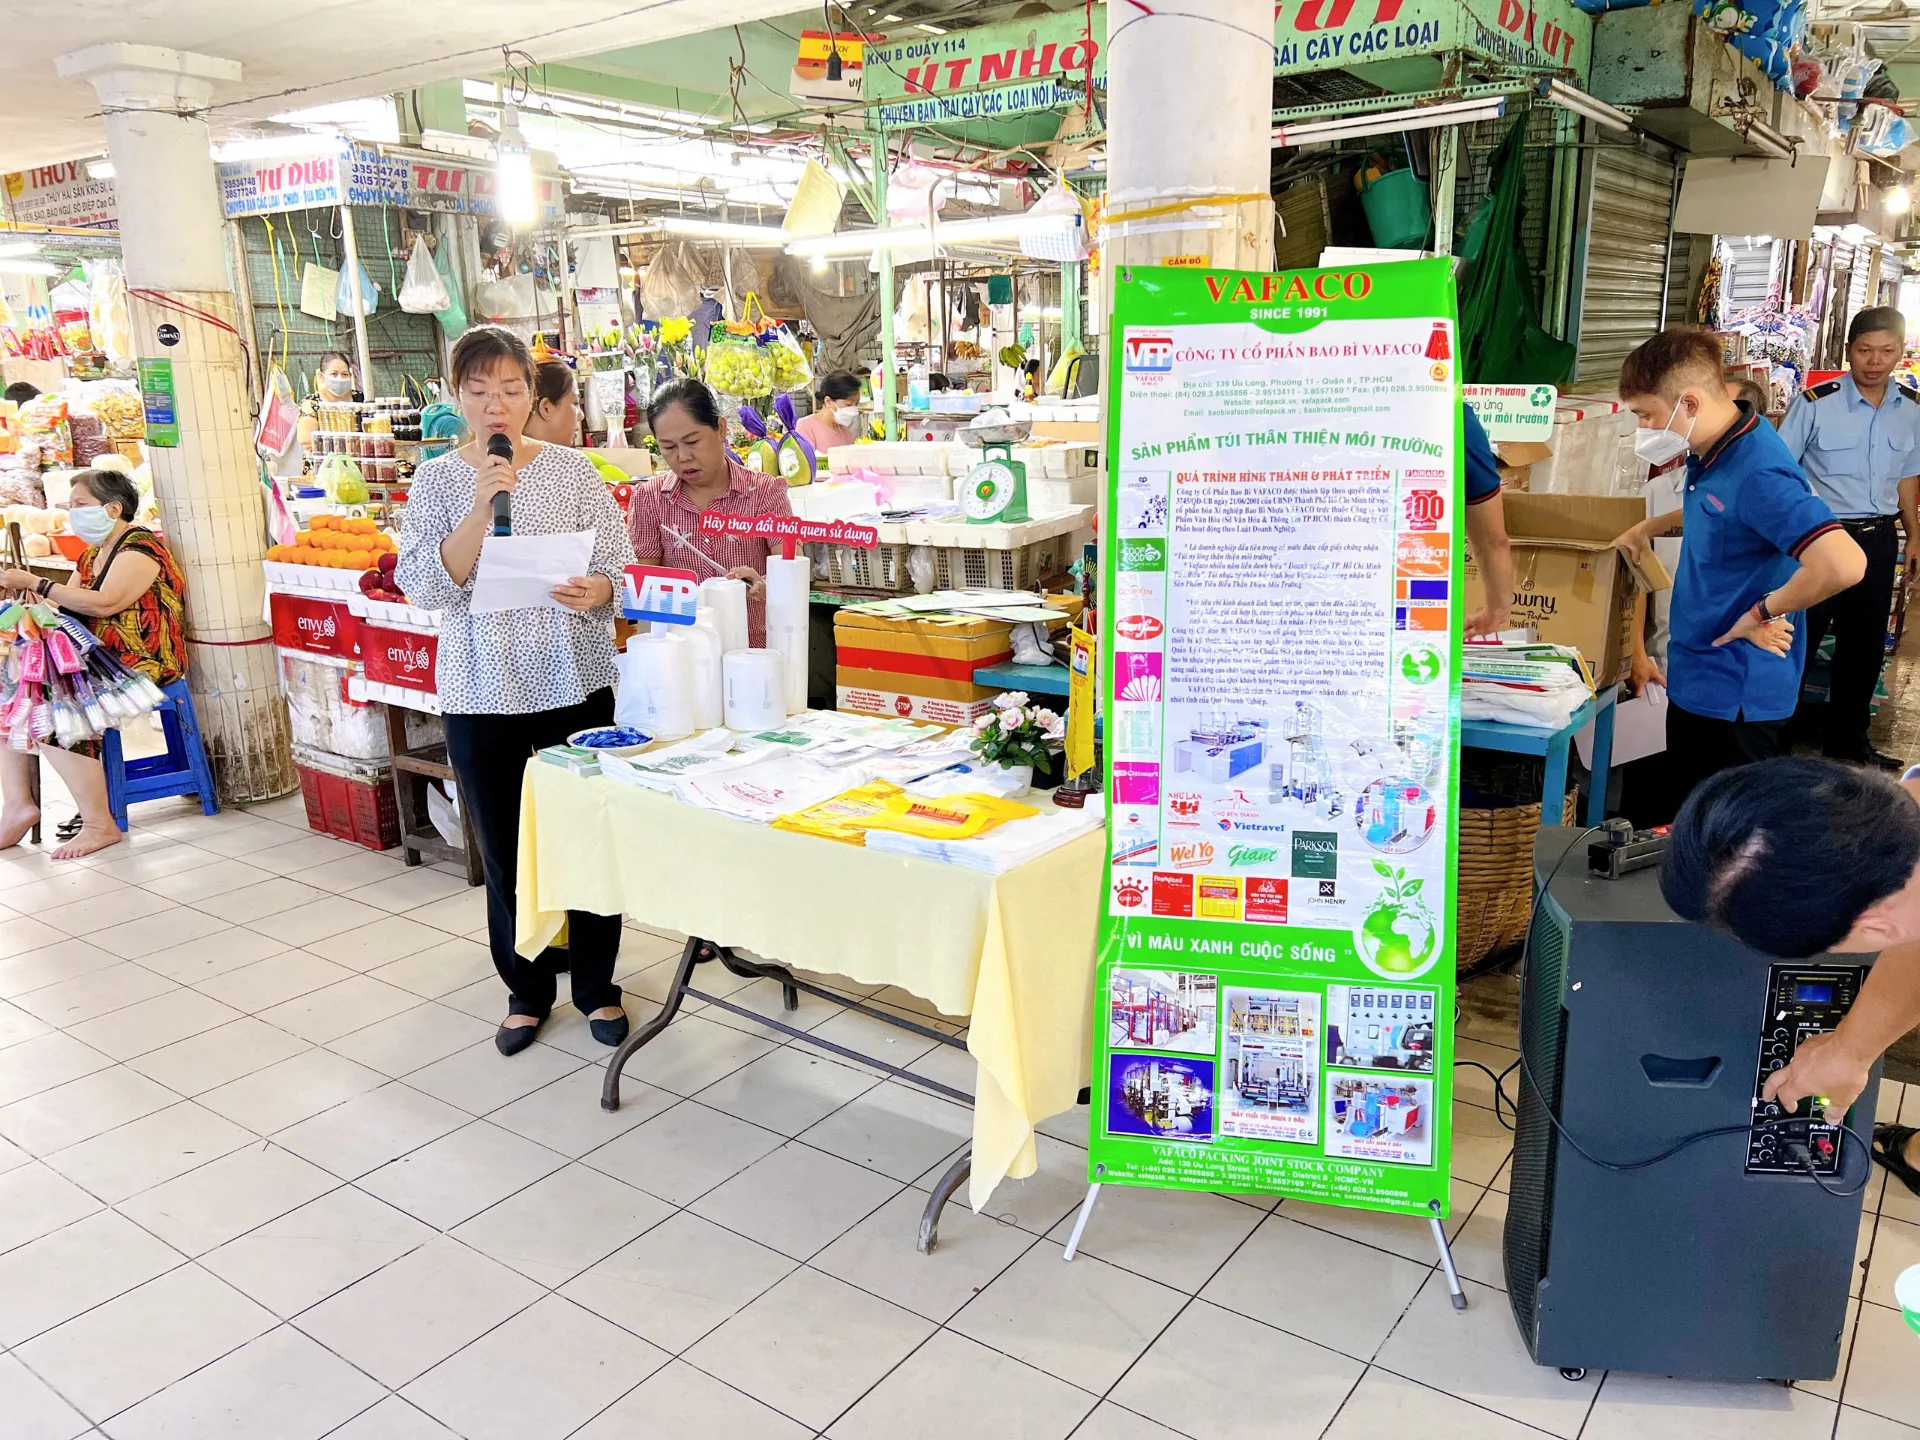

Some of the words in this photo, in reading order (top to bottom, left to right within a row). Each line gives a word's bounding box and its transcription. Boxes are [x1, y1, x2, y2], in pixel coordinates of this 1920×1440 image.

[867, 50, 892, 66] KHU
[896, 48, 903, 61] B
[944, 38, 966, 53] 114
[1306, 34, 1344, 61] CÂY
[1350, 25, 1388, 55] CÁC
[1395, 20, 1439, 49] LOẠI
[978, 27, 1099, 83] NHỎ
[983, 89, 1002, 114] CÁC
[1203, 272, 1373, 304] VAFACO
[1250, 308, 1290, 320] SINCE
[1297, 307, 1328, 319] 1991
[1126, 342, 1173, 368] VFP
[1176, 347, 1215, 362] CÔNG
[1220, 348, 1236, 360] TY
[1242, 342, 1262, 360] CỔ
[1266, 341, 1305, 359] PHẦN
[1310, 345, 1339, 358] BAO
[1343, 342, 1357, 357] BÌ
[1363, 343, 1422, 356] VAFACO
[1175, 390, 1191, 399] (84)
[1192, 389, 1248, 398] 028.3.8555856
[1352, 386, 1370, 394] Fax:
[1373, 386, 1388, 394] (84)
[1216, 380, 1230, 388] 139
[1359, 376, 1393, 384] TP.HCM
[1495, 387, 1526, 397] Phương
[1484, 399, 1503, 412] ứng
[1495, 413, 1512, 423] môi
[1516, 413, 1549, 425] trường
[1131, 442, 1162, 460] SẢN
[1166, 432, 1210, 455] PHẨM
[1215, 432, 1241, 449] TÚI
[1245, 429, 1287, 446] THÂN
[1292, 428, 1340, 447] THIỆN
[1345, 431, 1376, 448] MÔI
[1381, 435, 1444, 458] TRƯỜNG
[1176, 470, 1199, 484] QUÁ
[1311, 471, 1320, 481] &
[1323, 468, 1352, 481] PHÁT
[1402, 495, 1444, 521] 100
[703, 516, 725, 532] Hãy
[728, 517, 753, 534] thay
[755, 517, 774, 532] đổi
[777, 520, 798, 535] thói
[801, 525, 827, 539] quen
[829, 524, 842, 539] sử
[844, 528, 873, 544] dụng
[624, 574, 697, 616] VFP
[298, 616, 324, 640] envy
[388, 647, 416, 672] envy
[897, 702, 910, 710] STOP
[934, 710, 952, 718] Contents
[1168, 792, 1185, 800] NHƯ
[1185, 792, 1202, 800] LAN
[1233, 822, 1285, 832] Vietravel
[1170, 844, 1195, 862] Wel
[1198, 841, 1214, 857] Yo
[1228, 844, 1278, 867] Giant
[1127, 931, 1142, 949] VÌ
[1149, 933, 1184, 950] MÀU
[1190, 938, 1233, 955] XANH
[1240, 940, 1283, 960] CUỘC
[1290, 942, 1336, 962] SỐNG
[1152, 1146, 1197, 1158] VAFACO
[1200, 1150, 1249, 1165] PACKING
[1252, 1156, 1285, 1168] JOINT
[1287, 1159, 1324, 1172] STOCK
[1328, 1163, 1385, 1178] COMPANY
[1158, 1158, 1175, 1166] Add:
[1205, 1162, 1225, 1172] Long
[1254, 1166, 1263, 1174] 11
[1266, 1168, 1285, 1177] Ward
[1293, 1171, 1320, 1180] District
[1335, 1176, 1374, 1186] HCMC-VN
[1126, 1163, 1139, 1171] Tel:
[1142, 1164, 1161, 1173] (+84)
[1312, 1182, 1328, 1190] Fax:
[1331, 1184, 1351, 1193] (+84)
